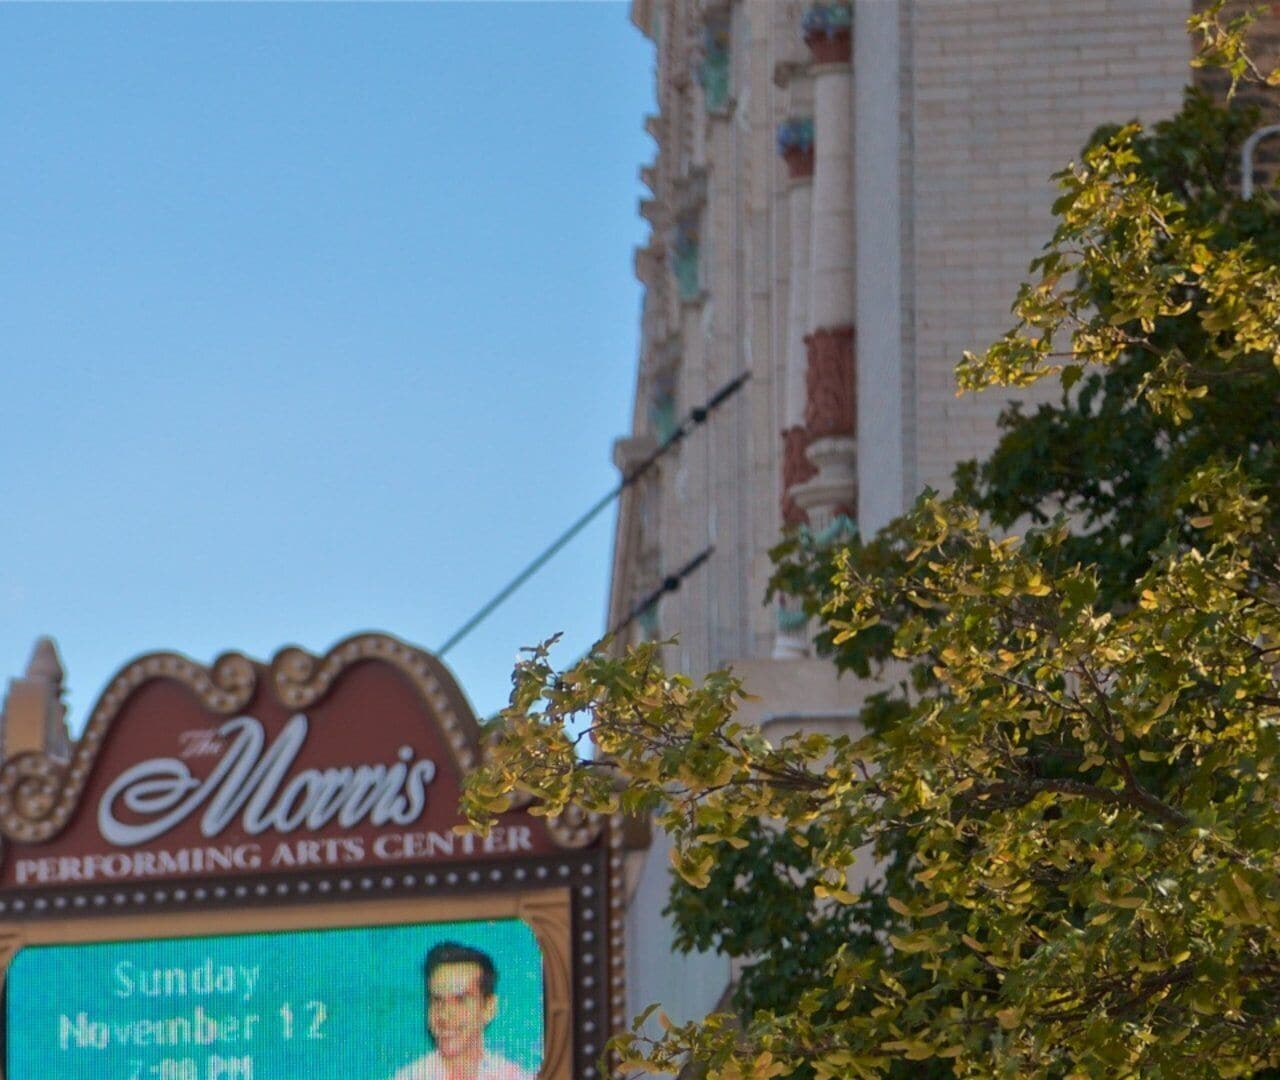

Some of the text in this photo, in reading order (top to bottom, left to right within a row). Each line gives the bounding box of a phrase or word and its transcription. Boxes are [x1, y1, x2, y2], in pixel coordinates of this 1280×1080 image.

[178, 728, 224, 758] The
[97, 712, 436, 847] Morris
[15, 825, 534, 883] PERFORMING ARTS CENTER
[114, 956, 260, 1001] Sunday
[59, 999, 328, 1050] November 12
